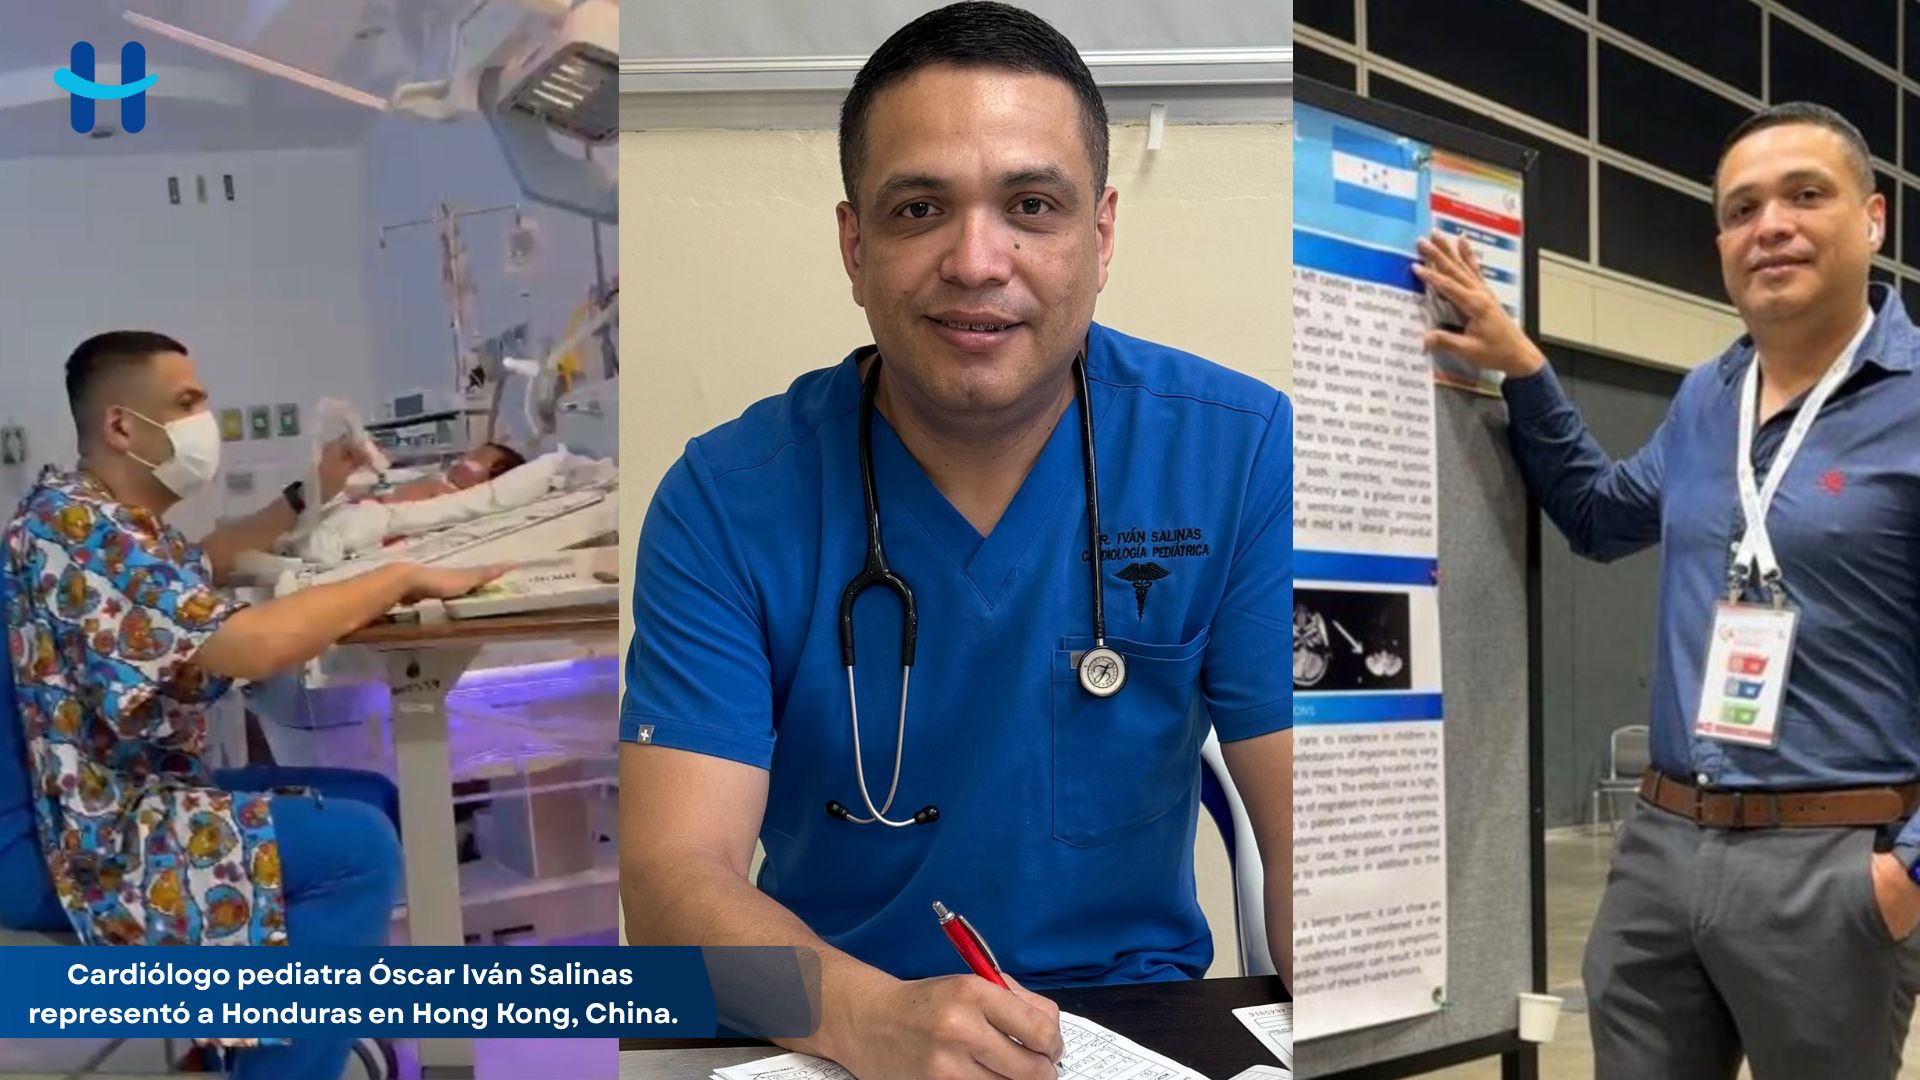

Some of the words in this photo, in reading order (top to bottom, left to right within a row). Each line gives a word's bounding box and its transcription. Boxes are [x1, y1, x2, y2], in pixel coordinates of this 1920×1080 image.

[1117, 527, 1146, 544] IVÁN
[1151, 528, 1202, 543] SALINAS
[1082, 540, 1147, 562] CDIOLOGÍA
[1152, 541, 1210, 559] PEDIÁTRICA
